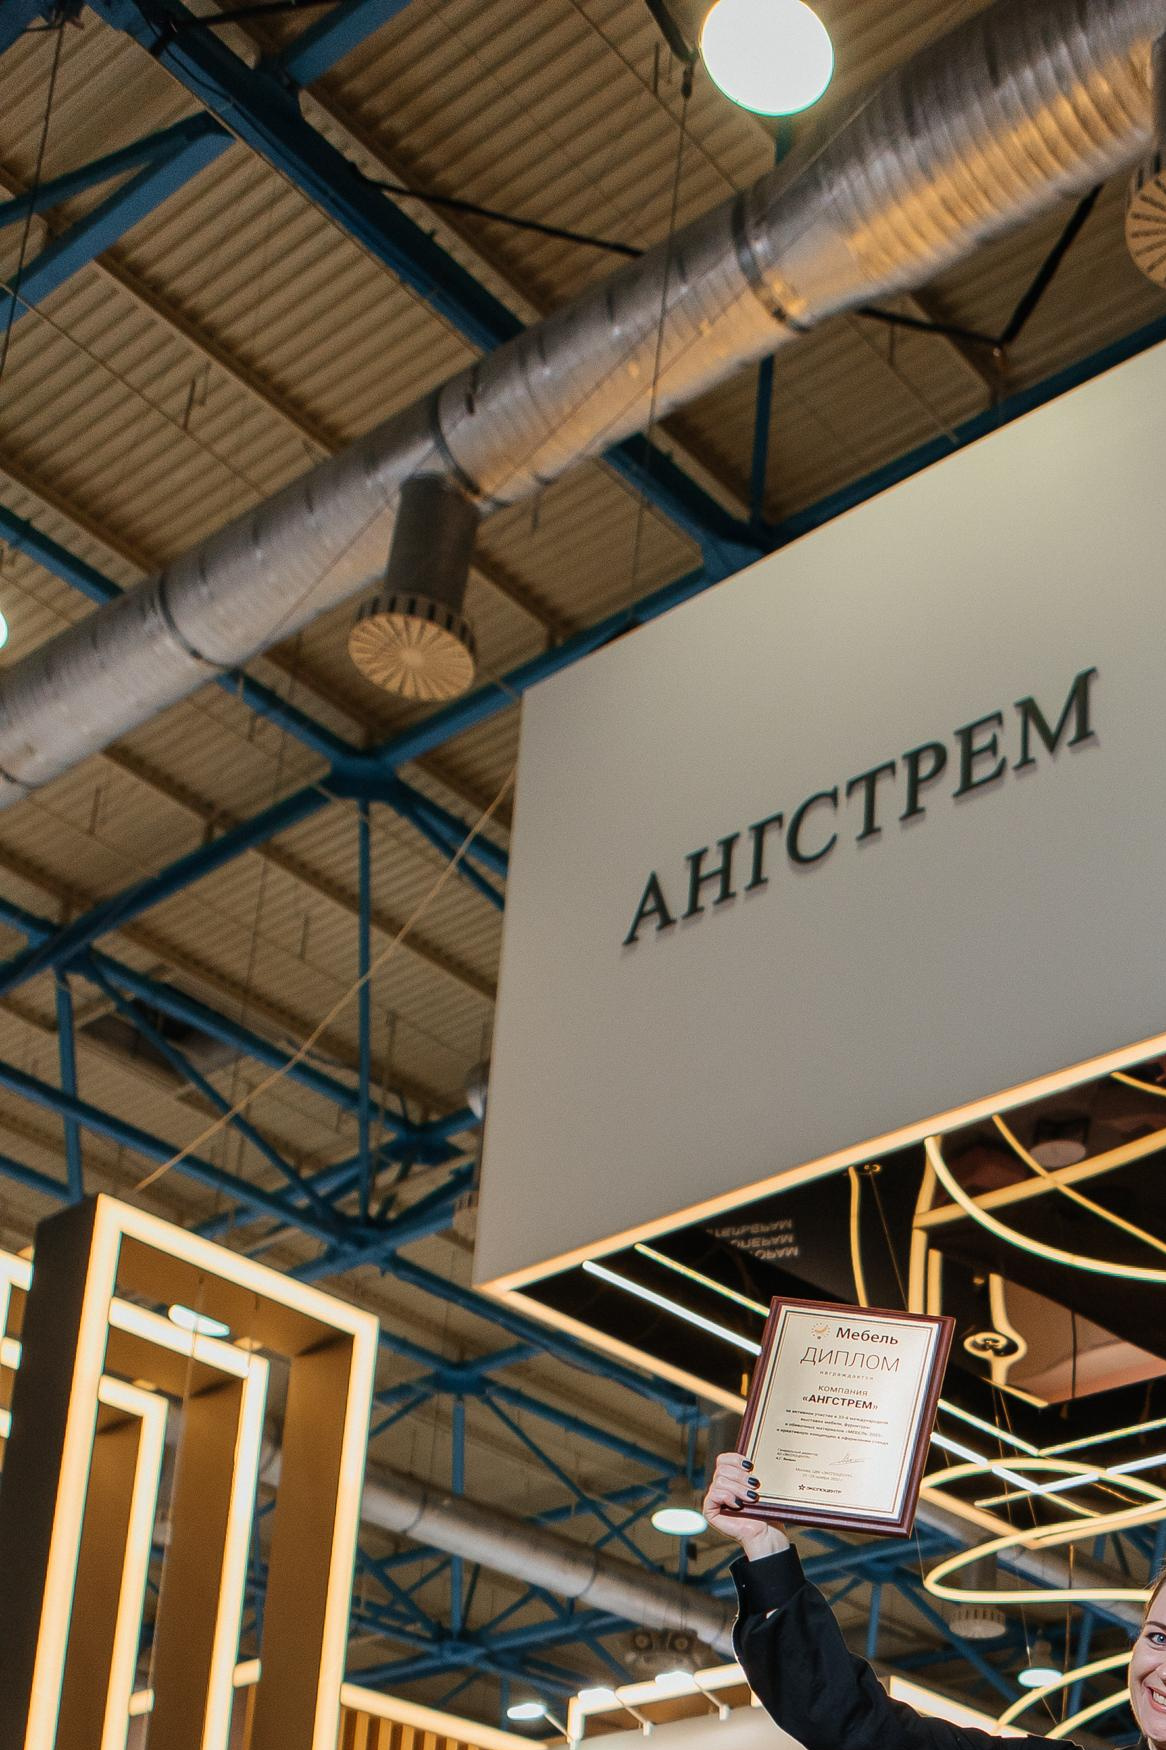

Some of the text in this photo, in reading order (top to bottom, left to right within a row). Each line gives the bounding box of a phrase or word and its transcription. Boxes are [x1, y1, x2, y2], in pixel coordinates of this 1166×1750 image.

[622, 666, 1098, 946] АНГСТРЕМ
[836, 1327, 898, 1345] Мебель
[800, 1346, 900, 1372] ДИПЛОМ
[820, 1370, 874, 1380] награждается
[818, 1385, 868, 1397] компания
[802, 1394, 878, 1410] «АНГСТРЕМ»
